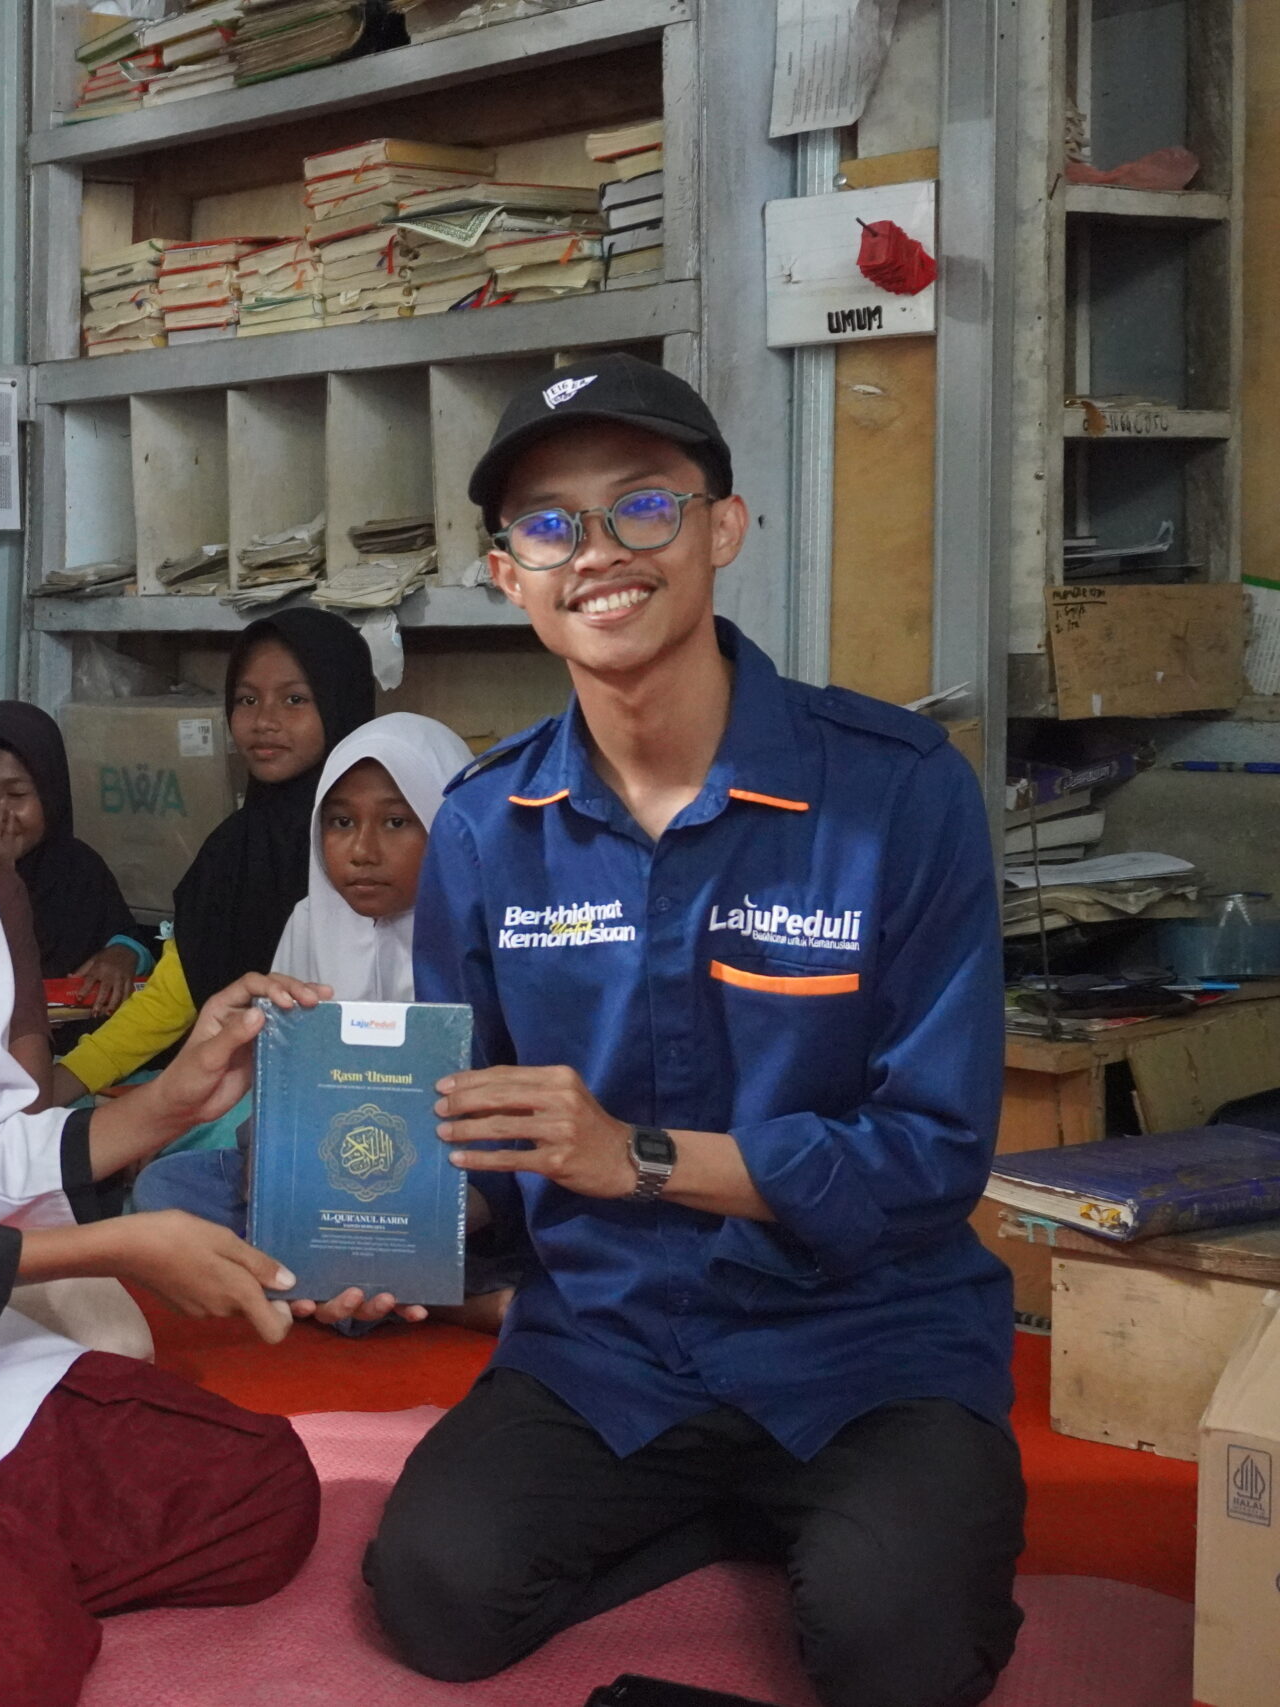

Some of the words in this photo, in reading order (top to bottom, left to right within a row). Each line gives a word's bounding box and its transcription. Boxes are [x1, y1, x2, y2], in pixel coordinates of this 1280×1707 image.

[827, 305, 883, 333] UMUM
[99, 766, 188, 817] BWA
[504, 900, 623, 925] Berkhidmat
[708, 904, 862, 937] LajuPeduli
[499, 923, 636, 948] Kemanusiaan
[808, 936, 860, 951] Kemanusiaan
[330, 1069, 363, 1083] Rasm
[365, 1070, 412, 1084] Utsmani
[380, 1215, 409, 1225] KARIM
